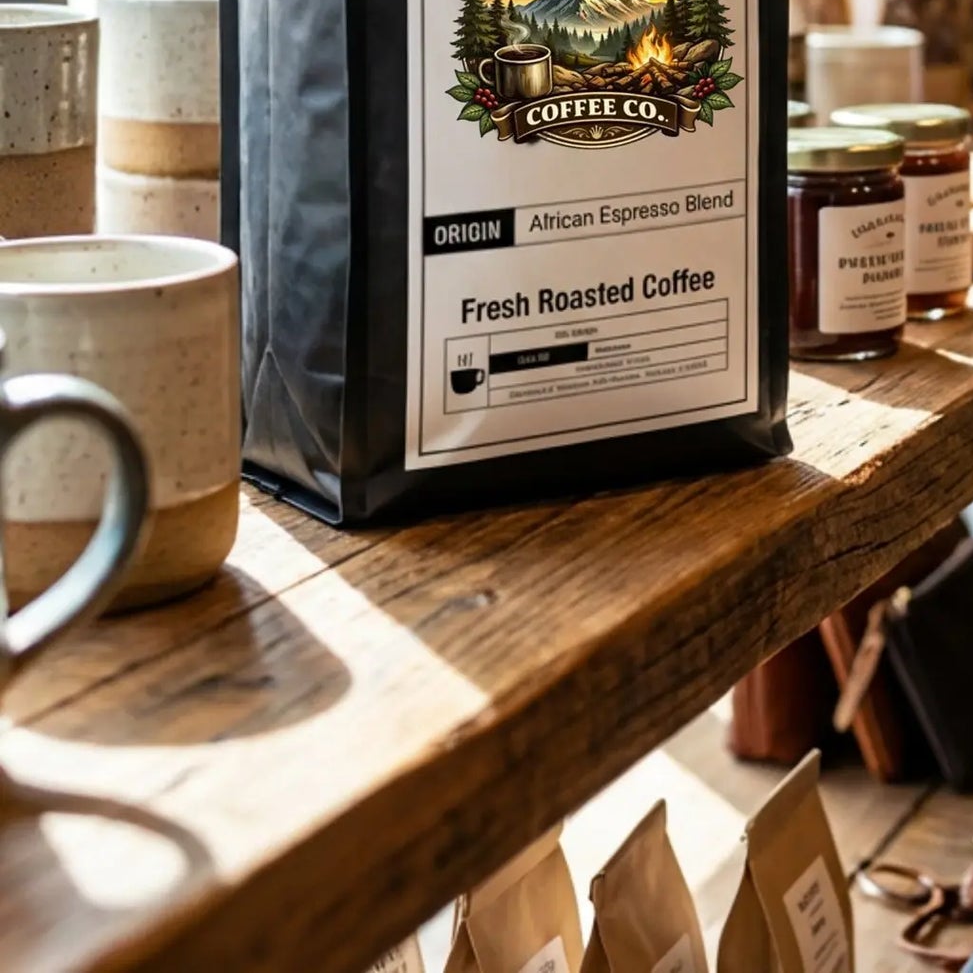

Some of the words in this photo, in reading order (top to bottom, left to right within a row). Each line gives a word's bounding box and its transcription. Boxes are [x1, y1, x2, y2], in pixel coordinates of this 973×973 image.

[526, 98, 617, 126] COFFEE
[529, 210, 594, 233] African
[599, 199, 681, 226] Espresso
[685, 190, 734, 213] Blend
[434, 220, 501, 246] ORIGIN
[461, 292, 530, 324] Fresh
[538, 277, 634, 314] Roasted
[642, 268, 716, 300] Coffee
